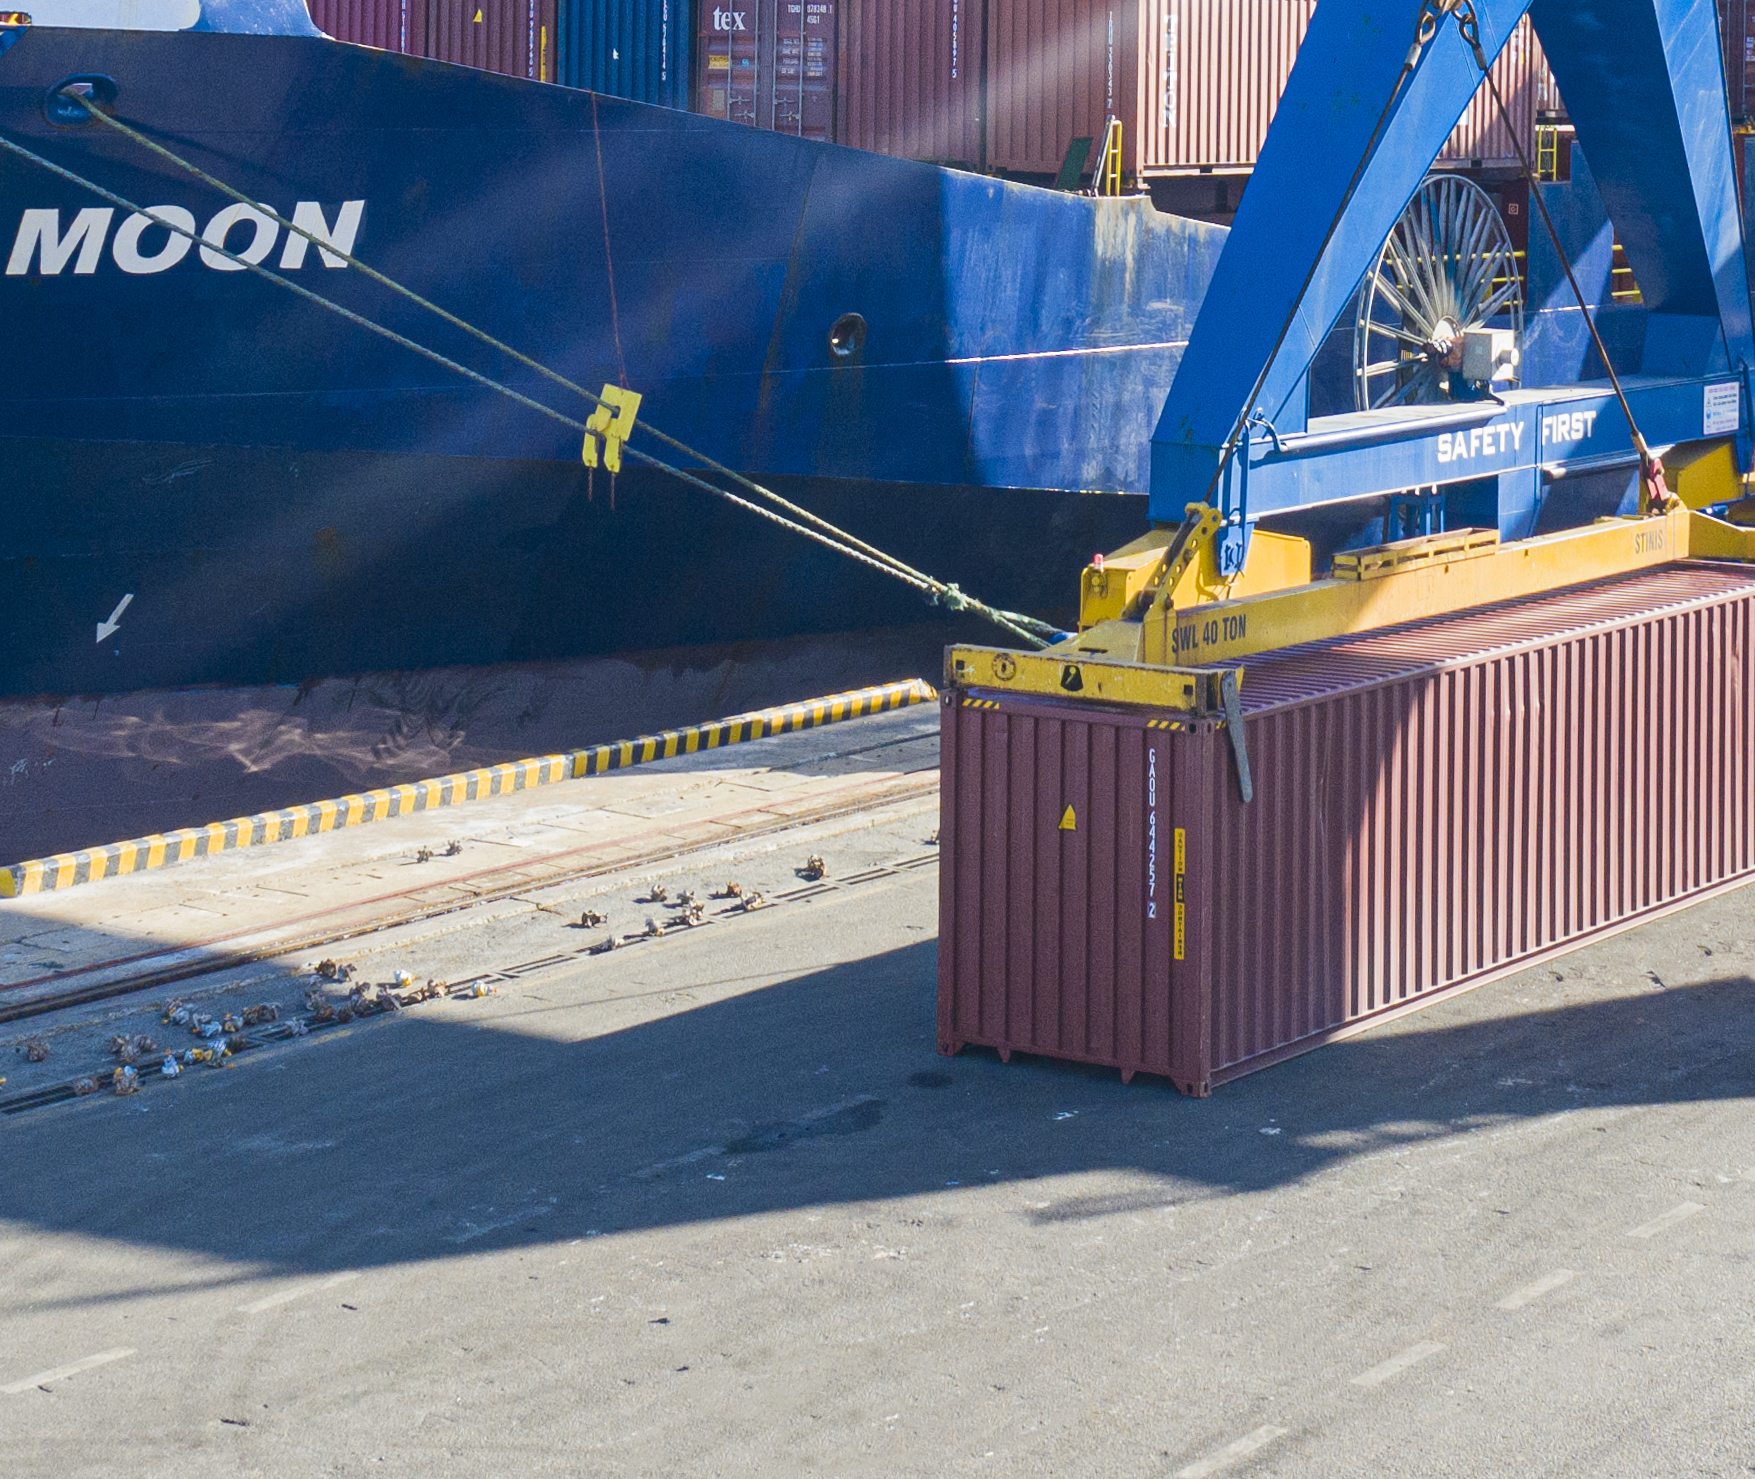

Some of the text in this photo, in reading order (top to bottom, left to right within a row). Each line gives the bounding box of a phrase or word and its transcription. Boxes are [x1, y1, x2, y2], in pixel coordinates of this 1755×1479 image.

[713, 7, 746, 31] tex
[6, 200, 365, 276] MOON
[1437, 410, 1597, 463] SAFETY FIRST
[1635, 529, 1663, 554] STINIS
[1171, 614, 1246, 653] SWL 40 TON
[1148, 747, 1156, 919] GAOU 644257 2
